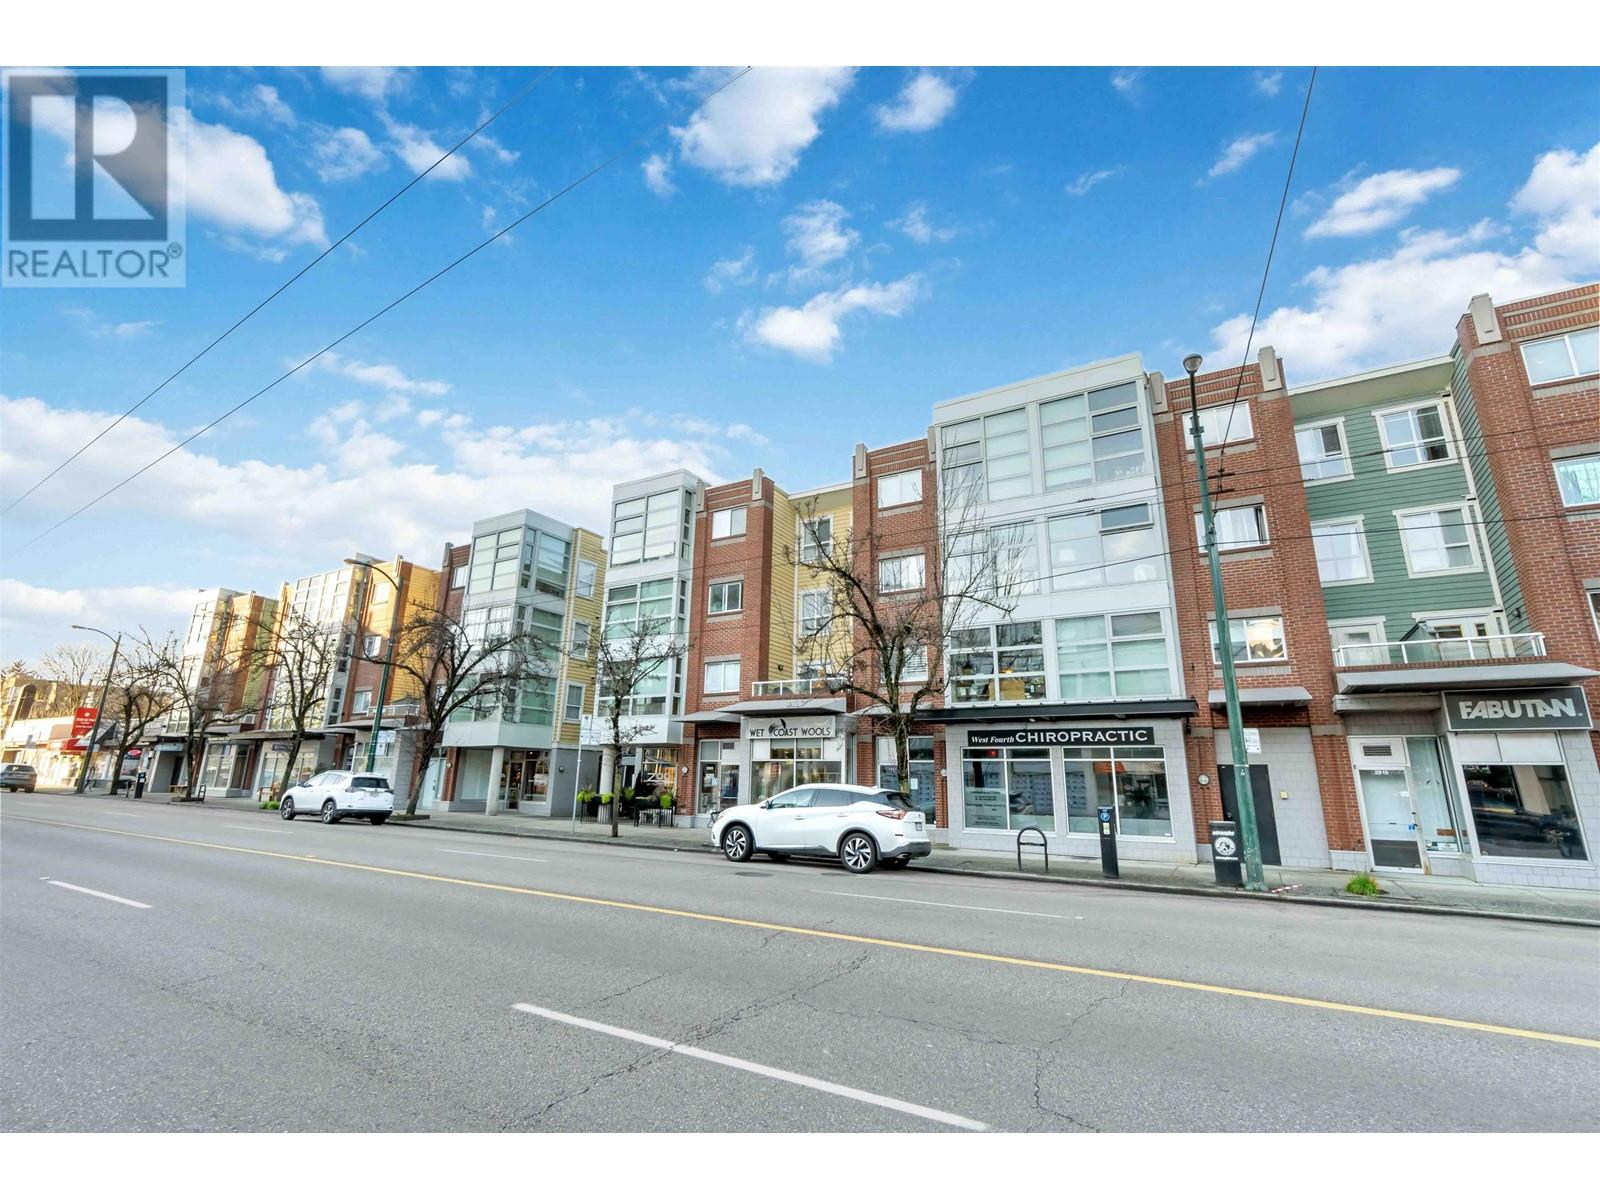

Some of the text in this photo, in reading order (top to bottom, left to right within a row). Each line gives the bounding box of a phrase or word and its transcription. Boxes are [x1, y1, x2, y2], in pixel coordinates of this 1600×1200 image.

[1458, 698, 1576, 719] FABUTAN
[749, 727, 831, 737] WET COAST WOOLS
[1015, 730, 1148, 743] CHIROPRACTIC
